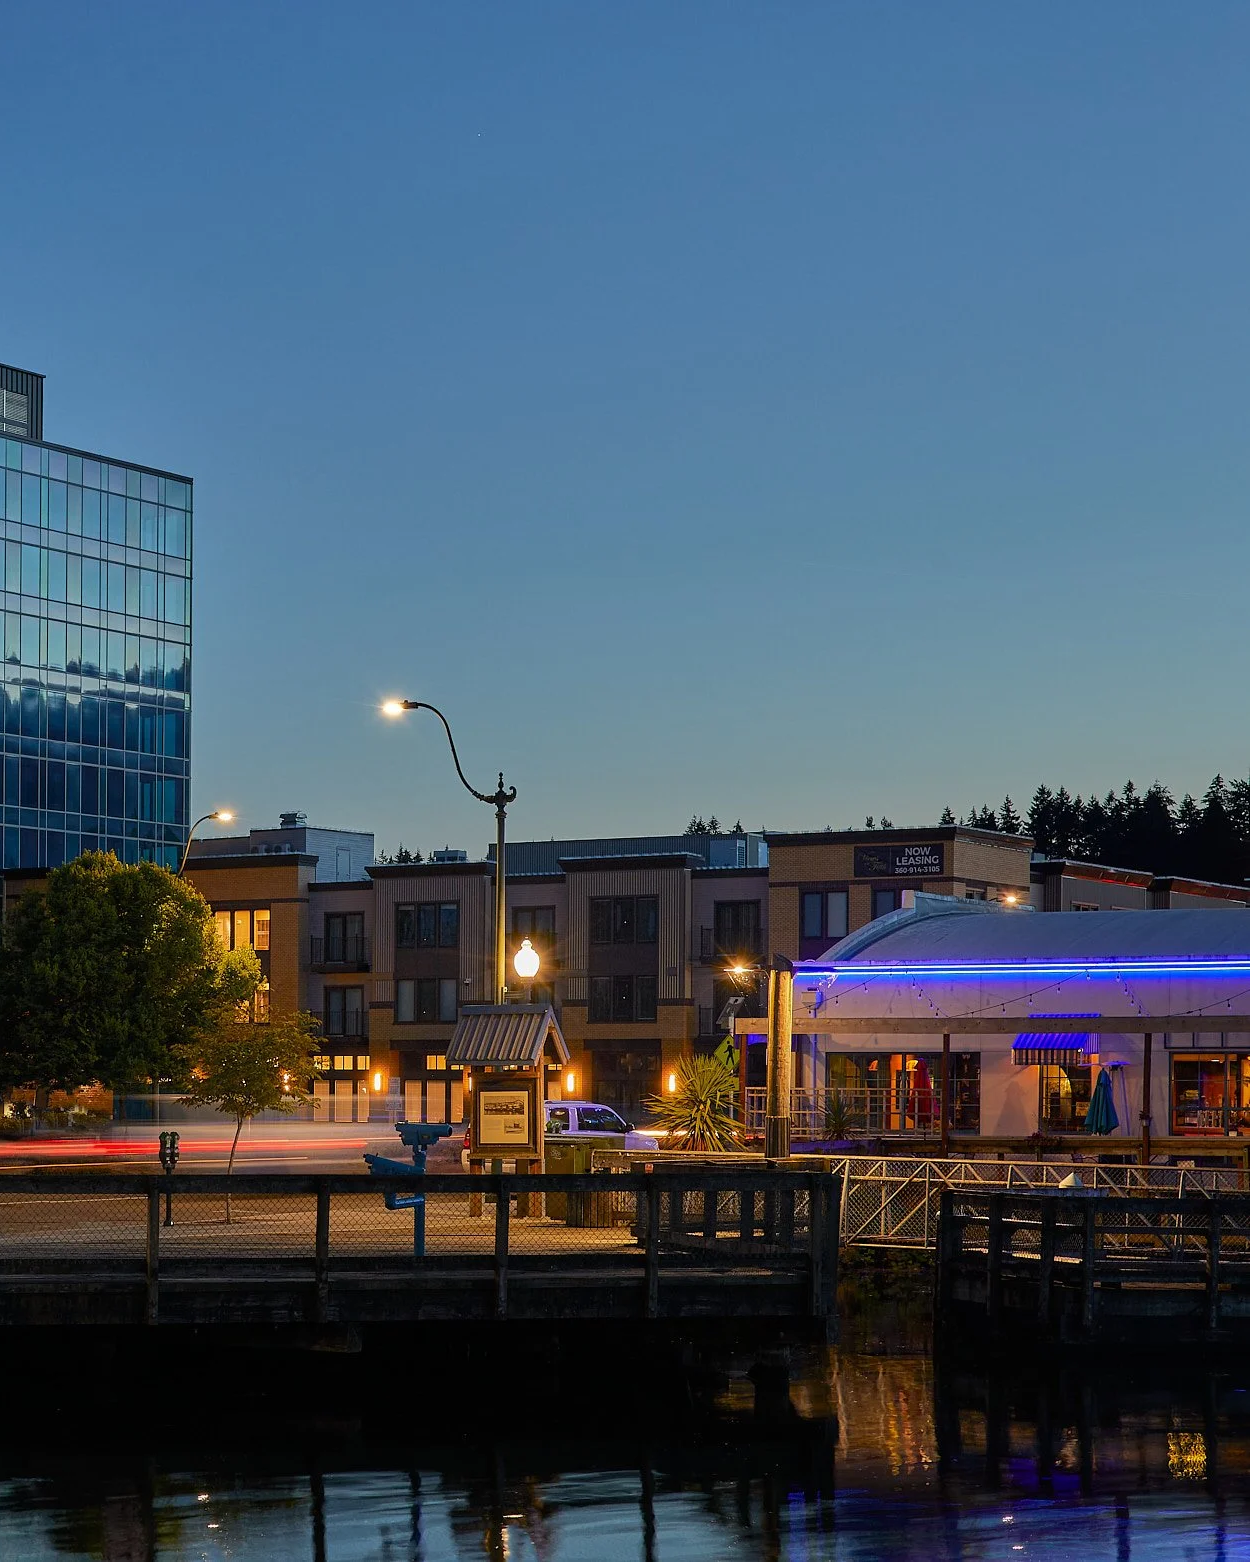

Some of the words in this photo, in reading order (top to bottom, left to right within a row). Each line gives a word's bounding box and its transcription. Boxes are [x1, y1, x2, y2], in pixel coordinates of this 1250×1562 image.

[905, 847, 931, 856] NOW
[896, 855, 939, 865] LEASING
[894, 866, 940, 874] 360-914-3105
